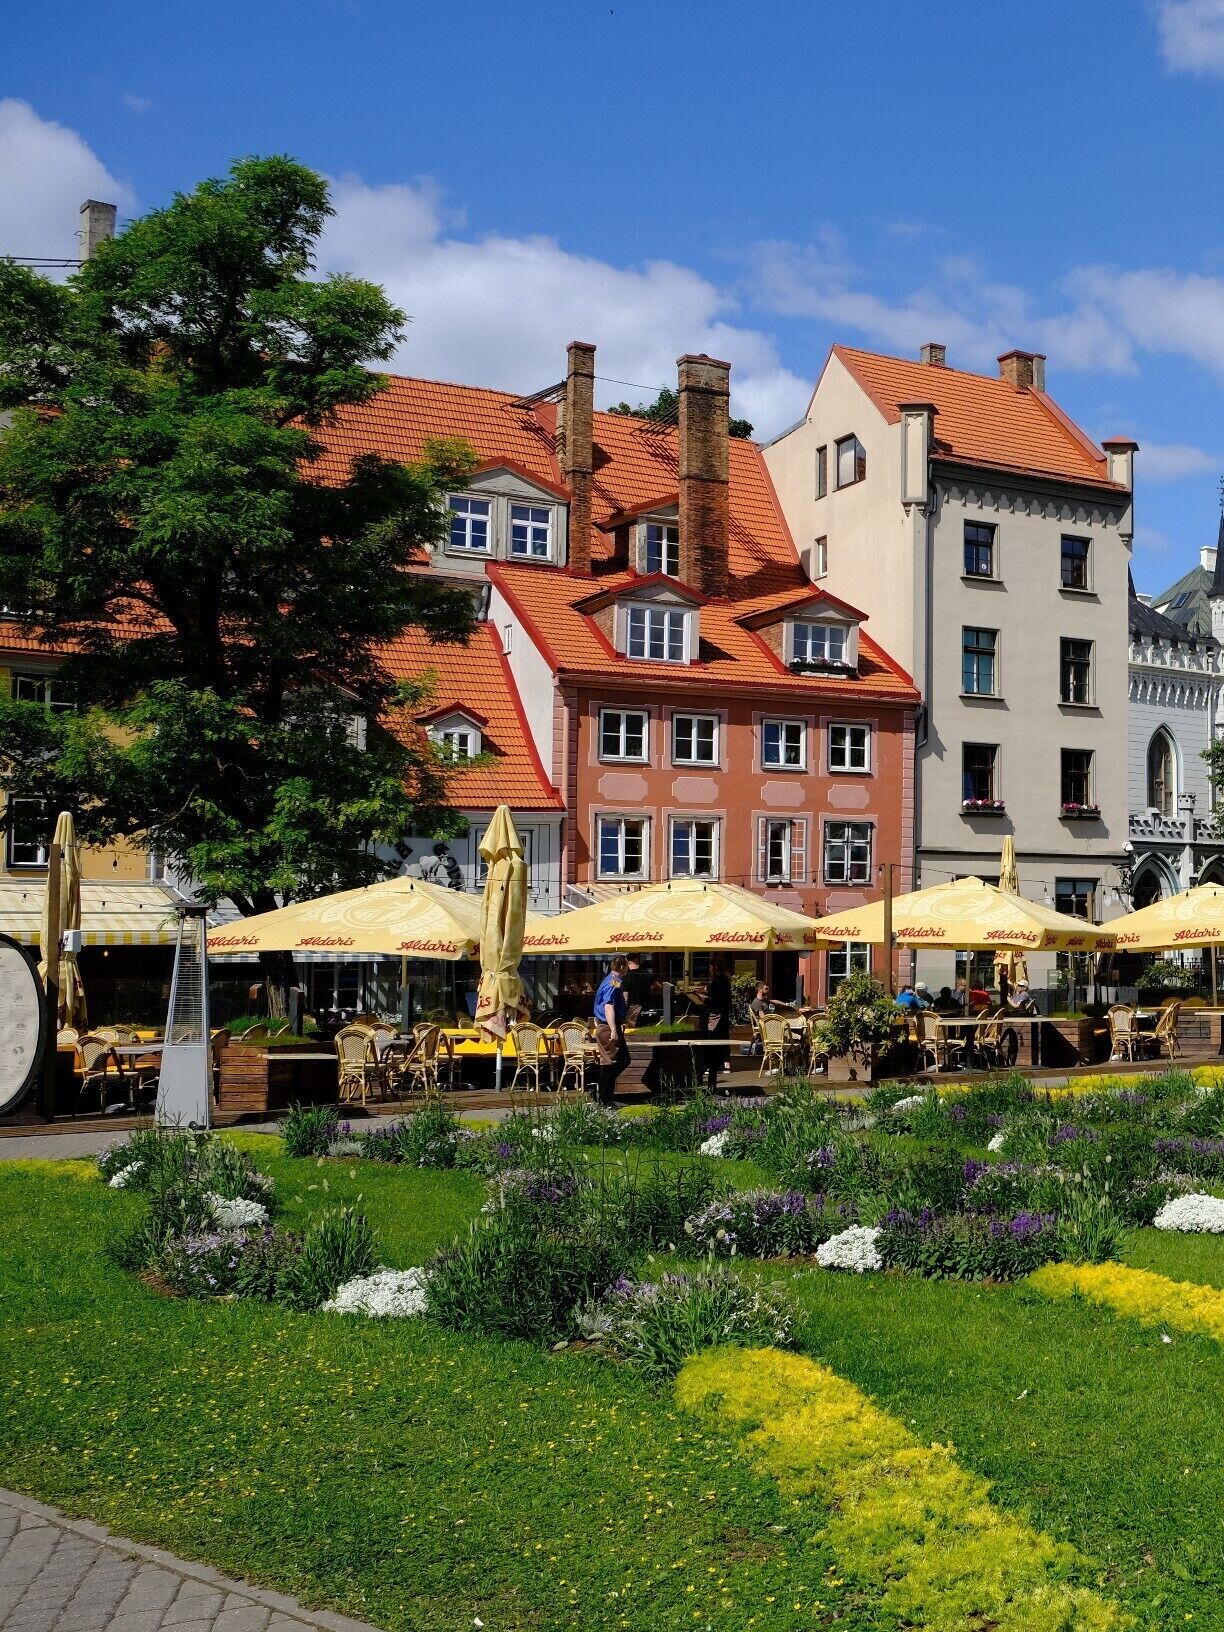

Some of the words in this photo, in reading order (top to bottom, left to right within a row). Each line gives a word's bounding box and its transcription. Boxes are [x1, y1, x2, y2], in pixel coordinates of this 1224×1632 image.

[606, 931, 664, 944] Aldaris
[706, 931, 765, 944] Aldaris
[814, 926, 862, 937] Aldaris
[897, 927, 947, 938] Aldaris
[983, 929, 1039, 942] Aldaris
[1173, 927, 1221, 941] Aldaris
[206, 935, 260, 949] Aldaris
[295, 936, 356, 947] Aldaris
[1116, 933, 1141, 944] aris
[396, 939, 460, 953] Aldaris
